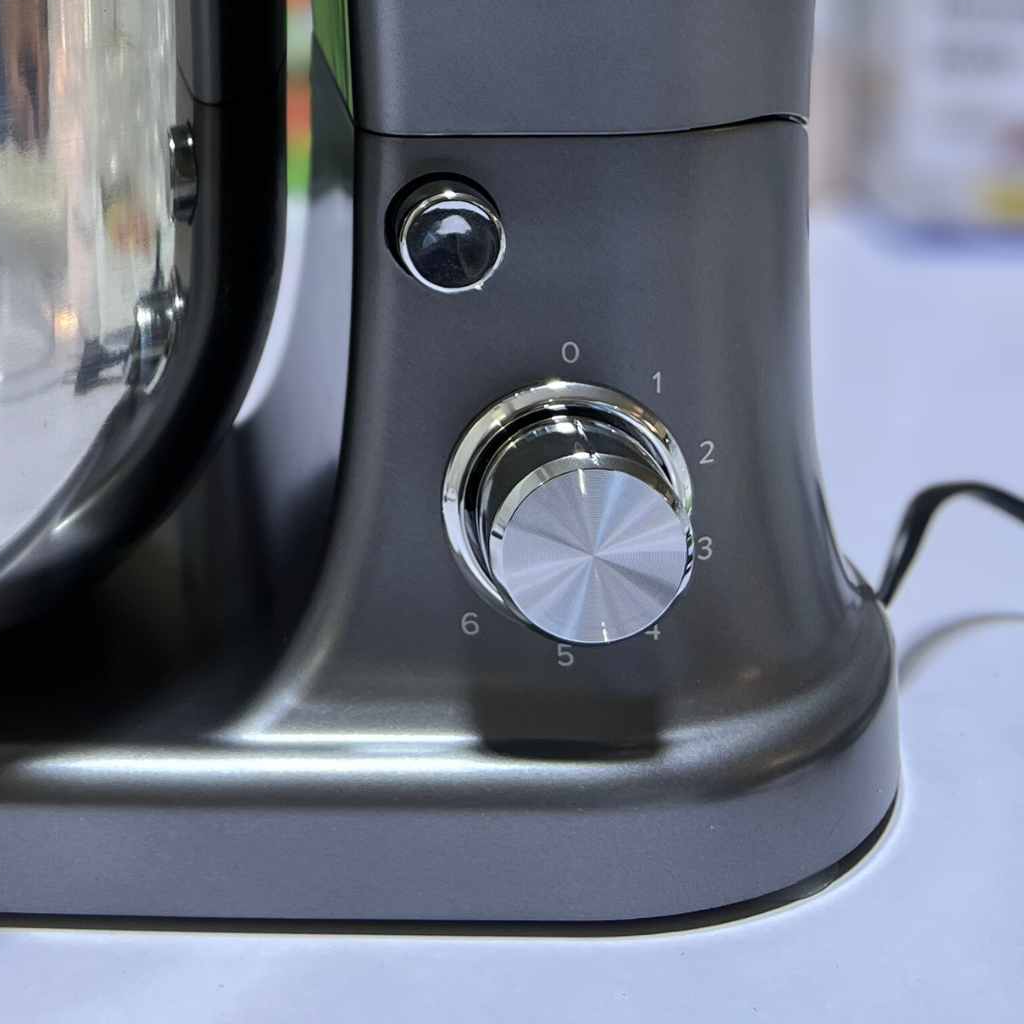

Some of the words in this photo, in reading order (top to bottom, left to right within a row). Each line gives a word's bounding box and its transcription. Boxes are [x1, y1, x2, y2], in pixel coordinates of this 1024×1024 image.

[561, 341, 580, 364] 0
[652, 371, 663, 394] 1
[698, 440, 716, 465] 2
[697, 536, 714, 561] 3
[460, 611, 480, 635] 6
[557, 644, 575, 667] 5
